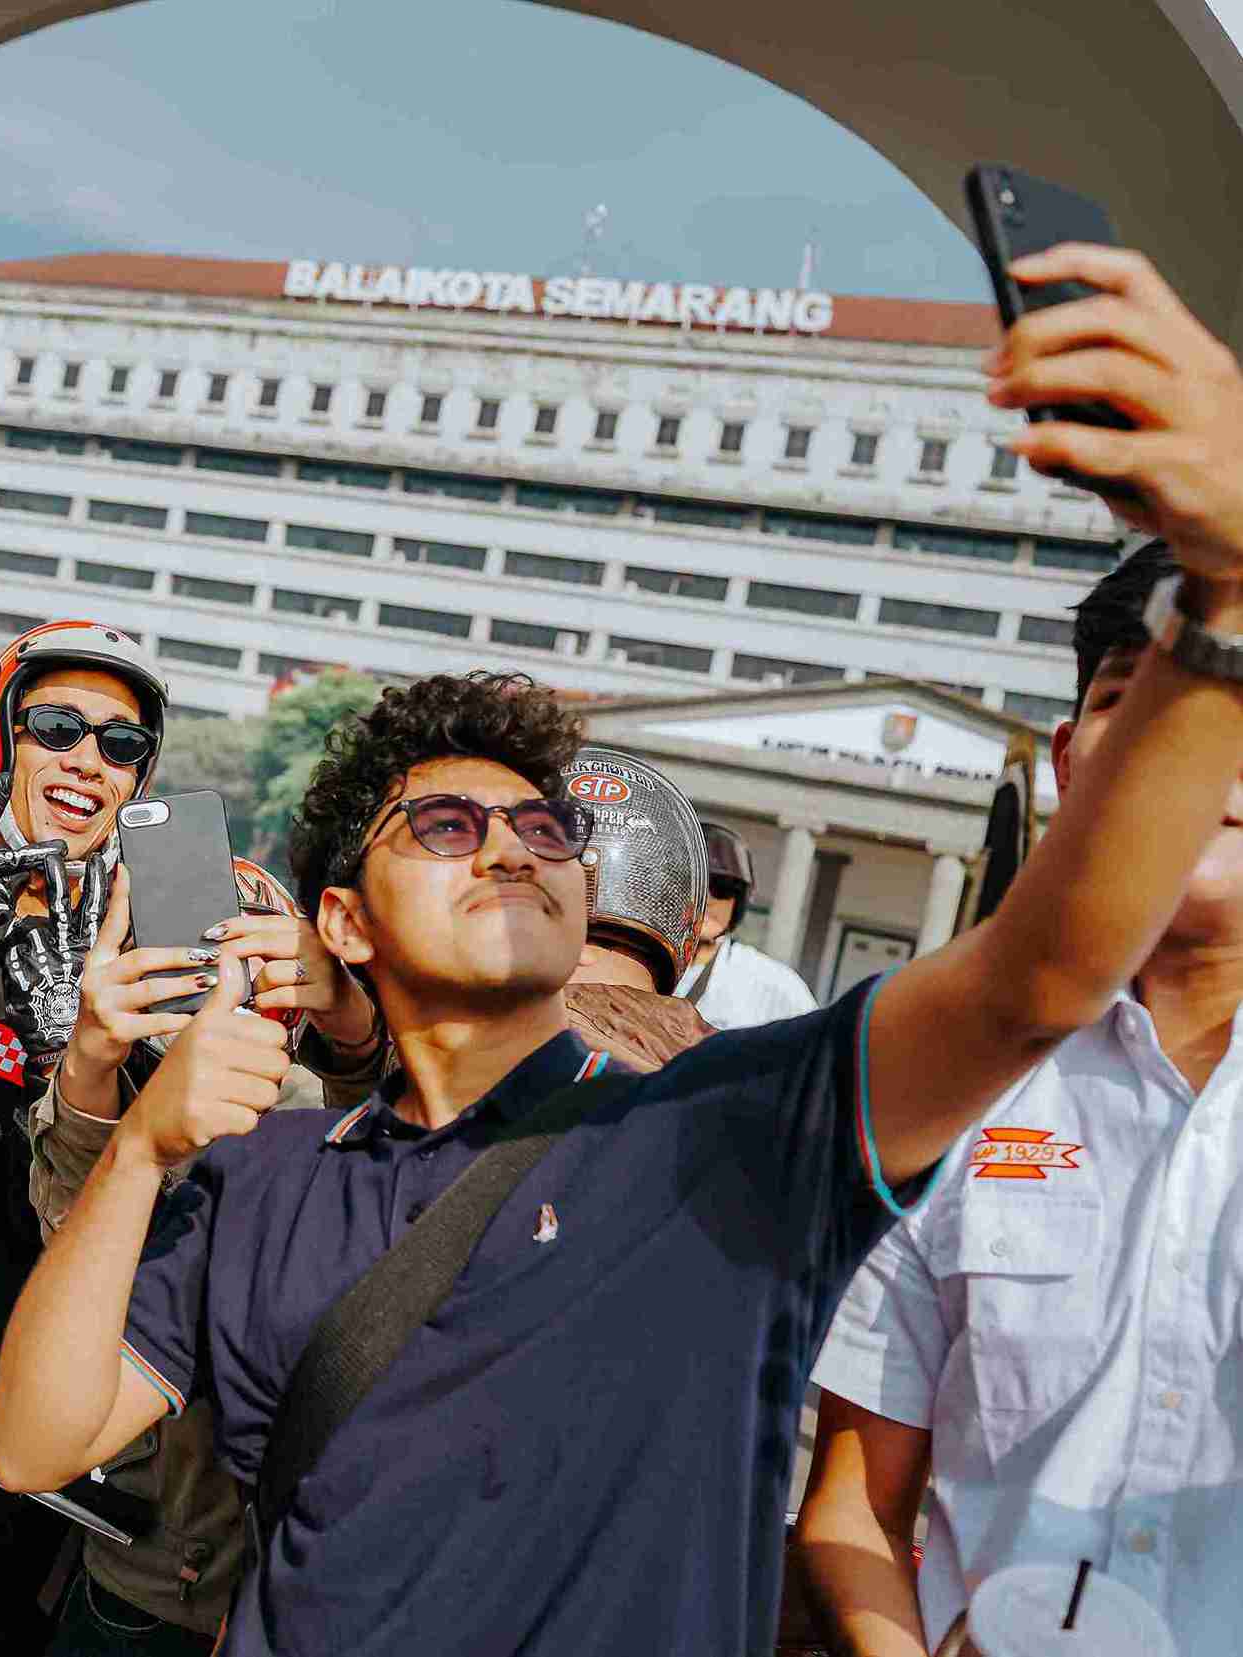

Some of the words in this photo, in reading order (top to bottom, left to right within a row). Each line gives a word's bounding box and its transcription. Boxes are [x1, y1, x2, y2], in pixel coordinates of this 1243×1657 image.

[283, 259, 535, 312] BALAIKOTA
[542, 275, 834, 333] SEMARANG
[577, 778, 622, 797] STP
